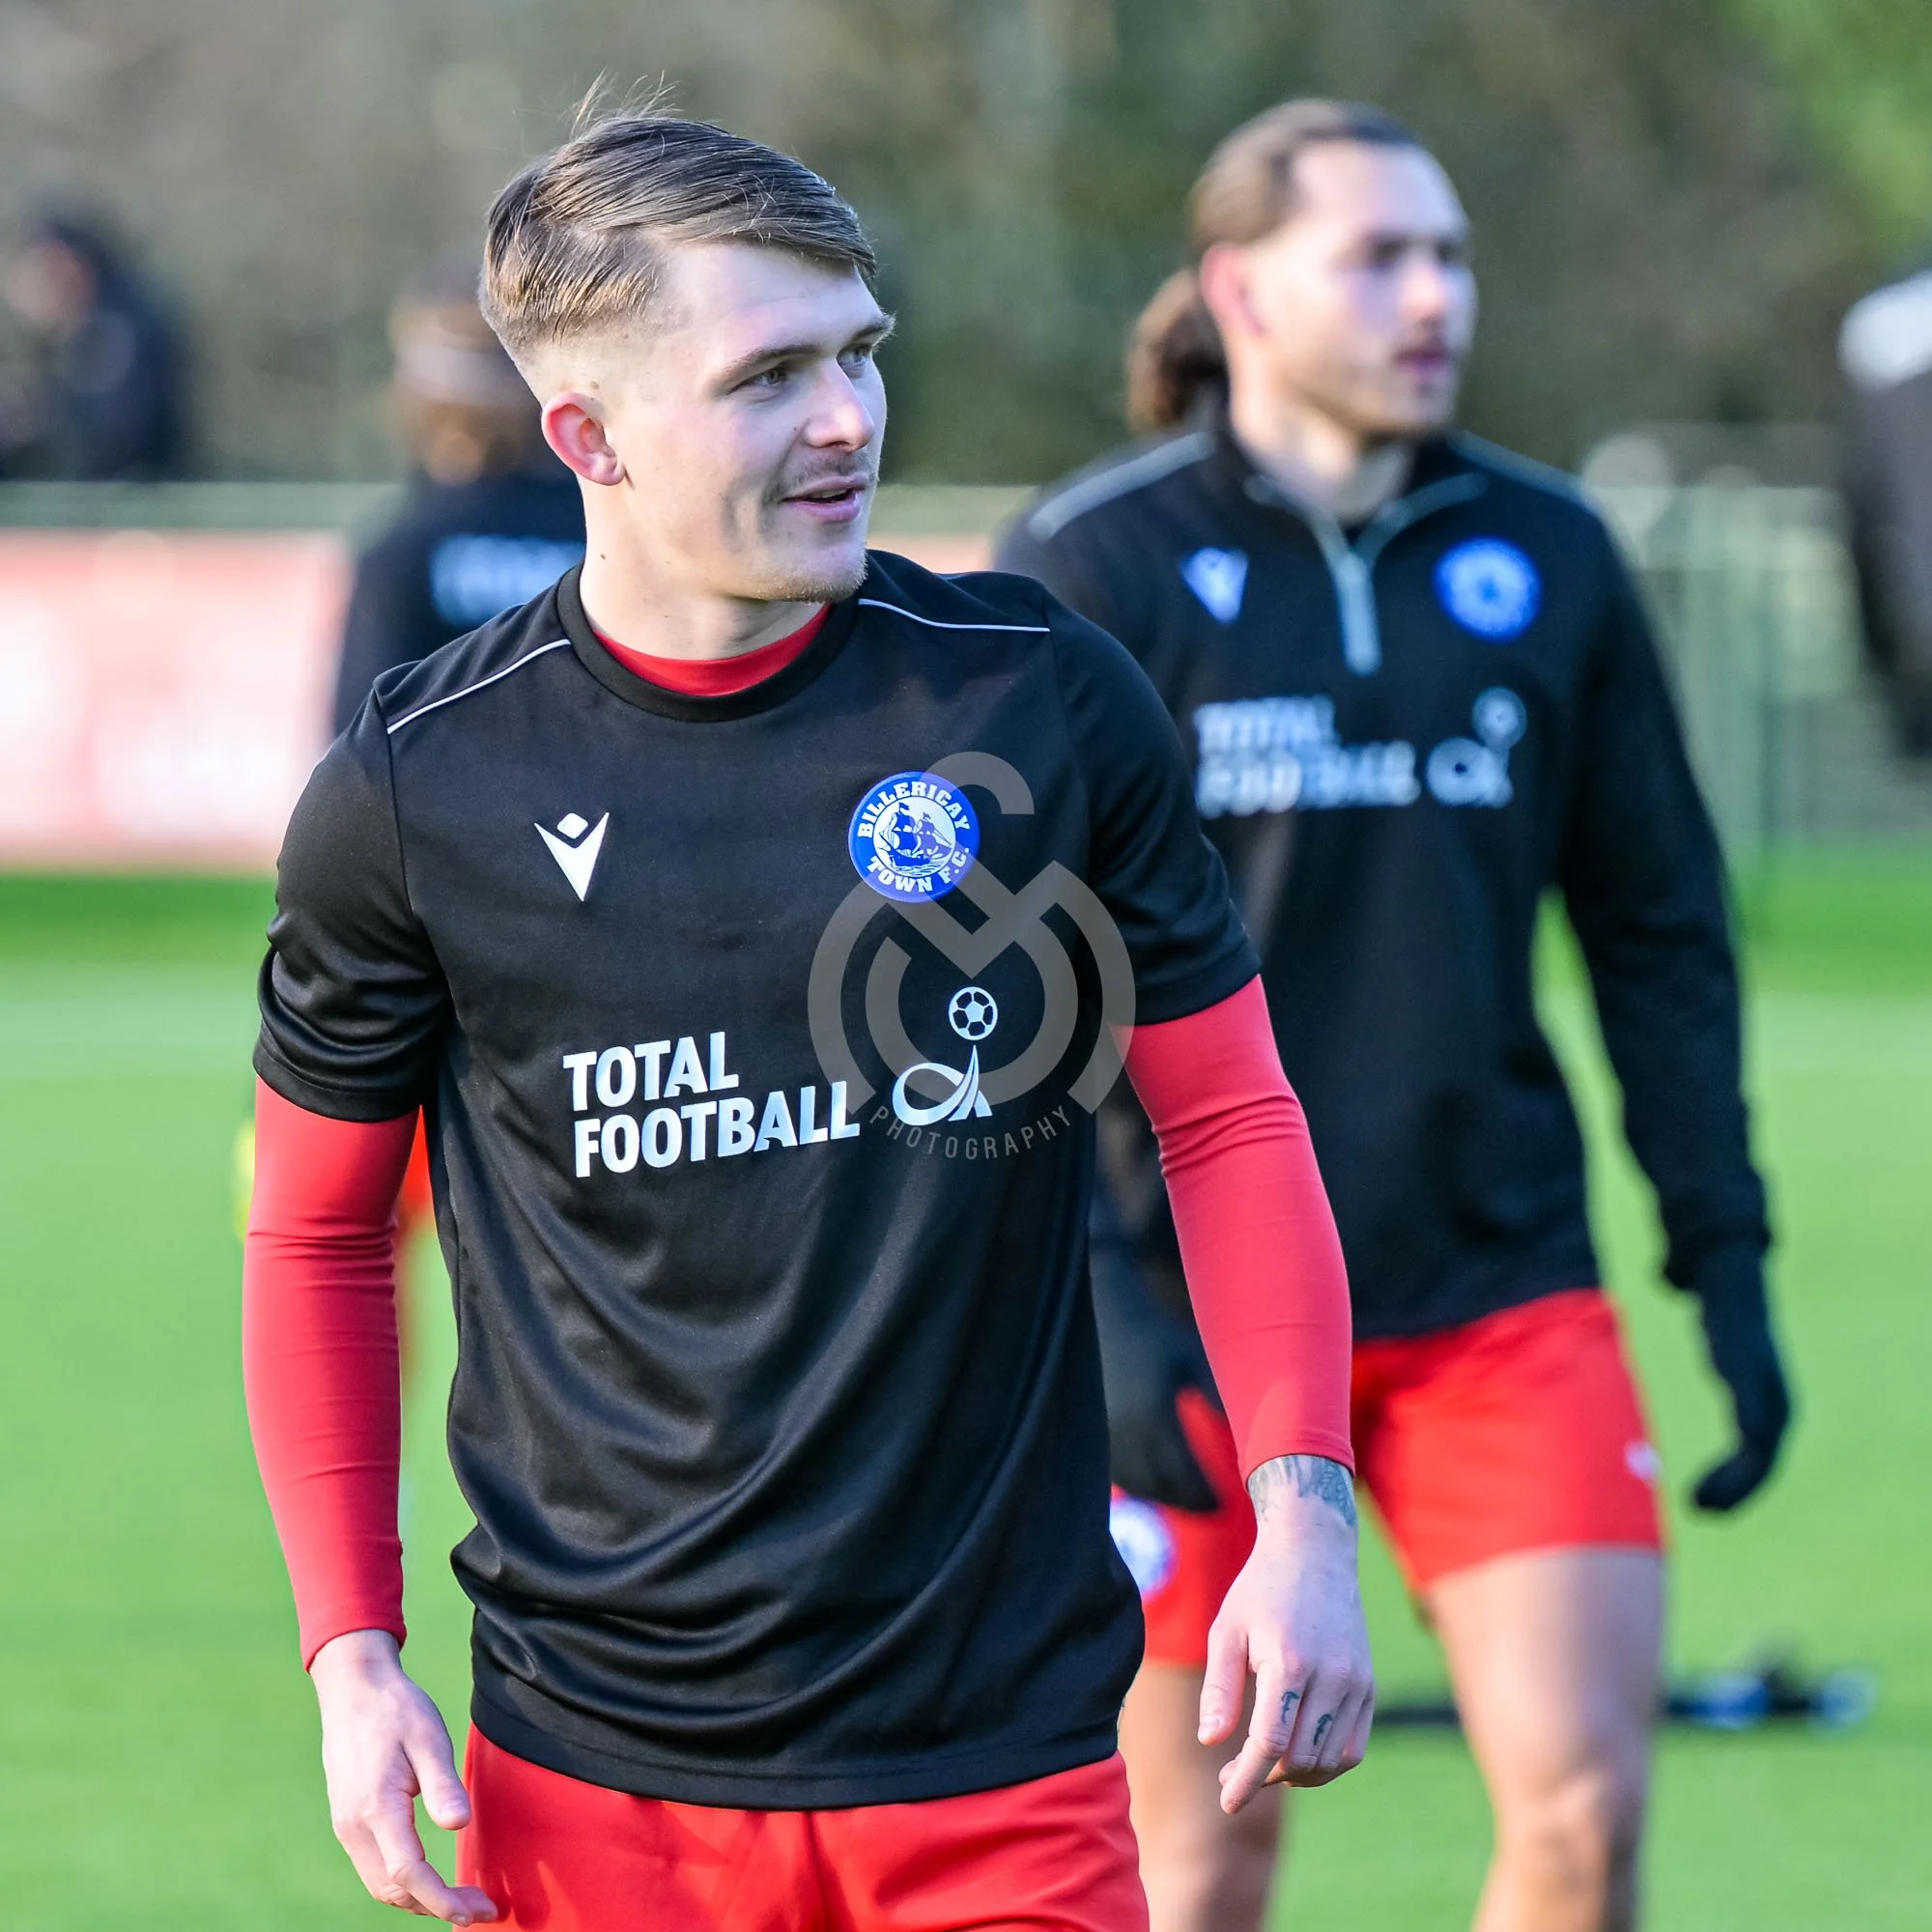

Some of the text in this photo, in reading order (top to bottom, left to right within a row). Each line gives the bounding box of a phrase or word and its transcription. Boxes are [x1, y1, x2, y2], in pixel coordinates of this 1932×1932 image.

[858, 781, 970, 838] BILLERICAY
[867, 856, 933, 893] TOWN
[563, 1032, 739, 1111] TOTAL
[575, 1081, 860, 1178] FOOTBALL
